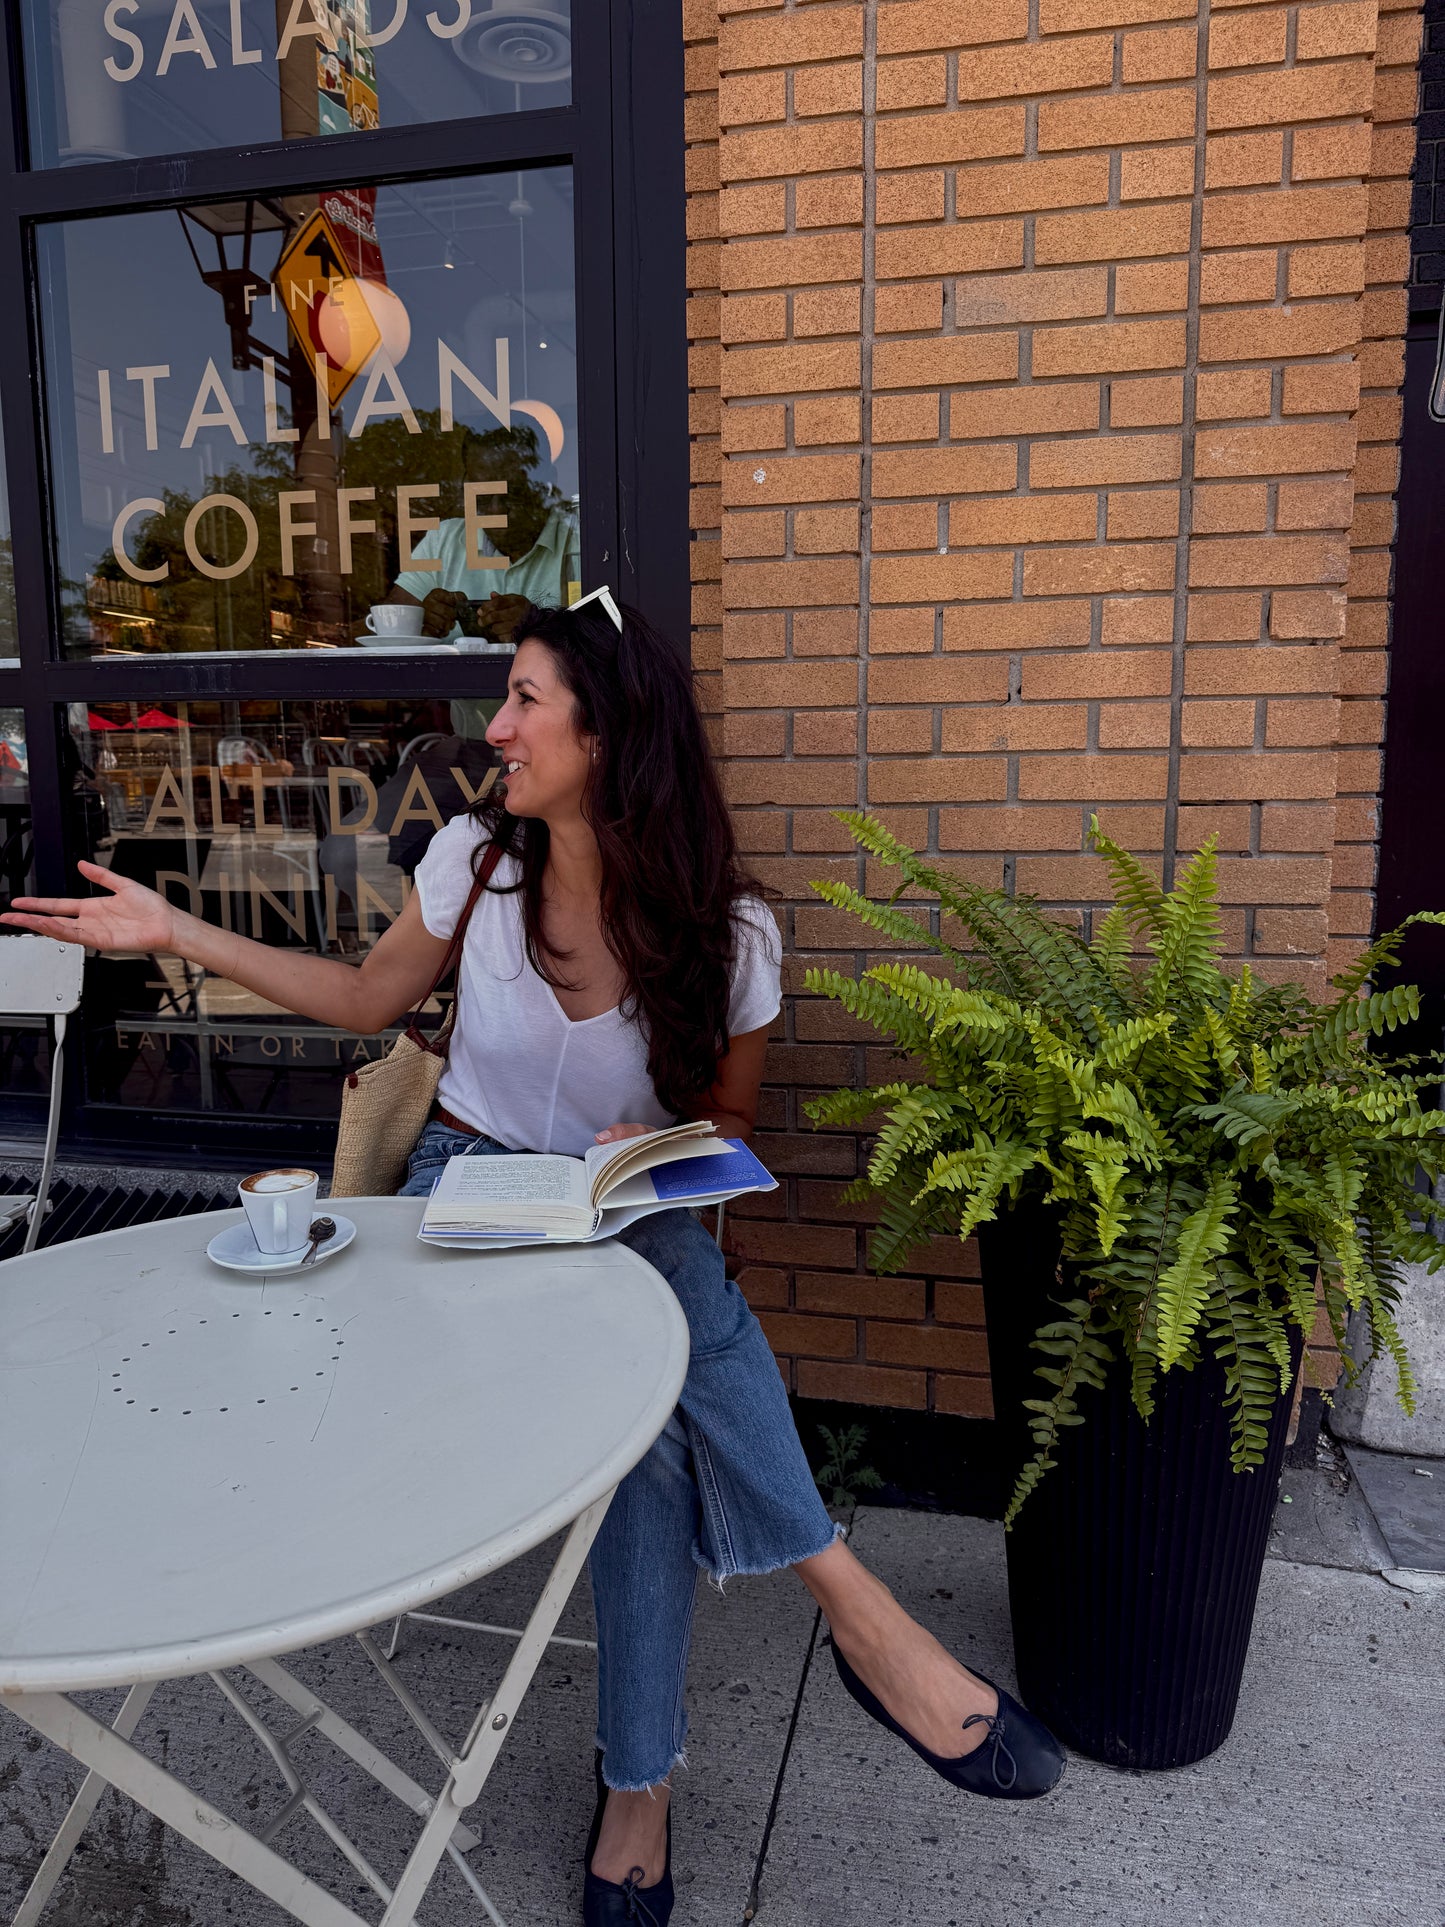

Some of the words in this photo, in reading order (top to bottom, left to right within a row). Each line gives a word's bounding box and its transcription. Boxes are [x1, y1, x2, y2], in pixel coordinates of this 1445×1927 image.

[243, 276, 345, 315] FINE
[97, 337, 512, 454] ITALIAN
[111, 480, 511, 583] COFFEE
[143, 763, 283, 835] ALL
[327, 763, 501, 836] DAY
[155, 869, 412, 942] DININ
[116, 1027, 174, 1052] EAT
[259, 1035, 306, 1058] OR
[329, 1036, 396, 1061] TAK
